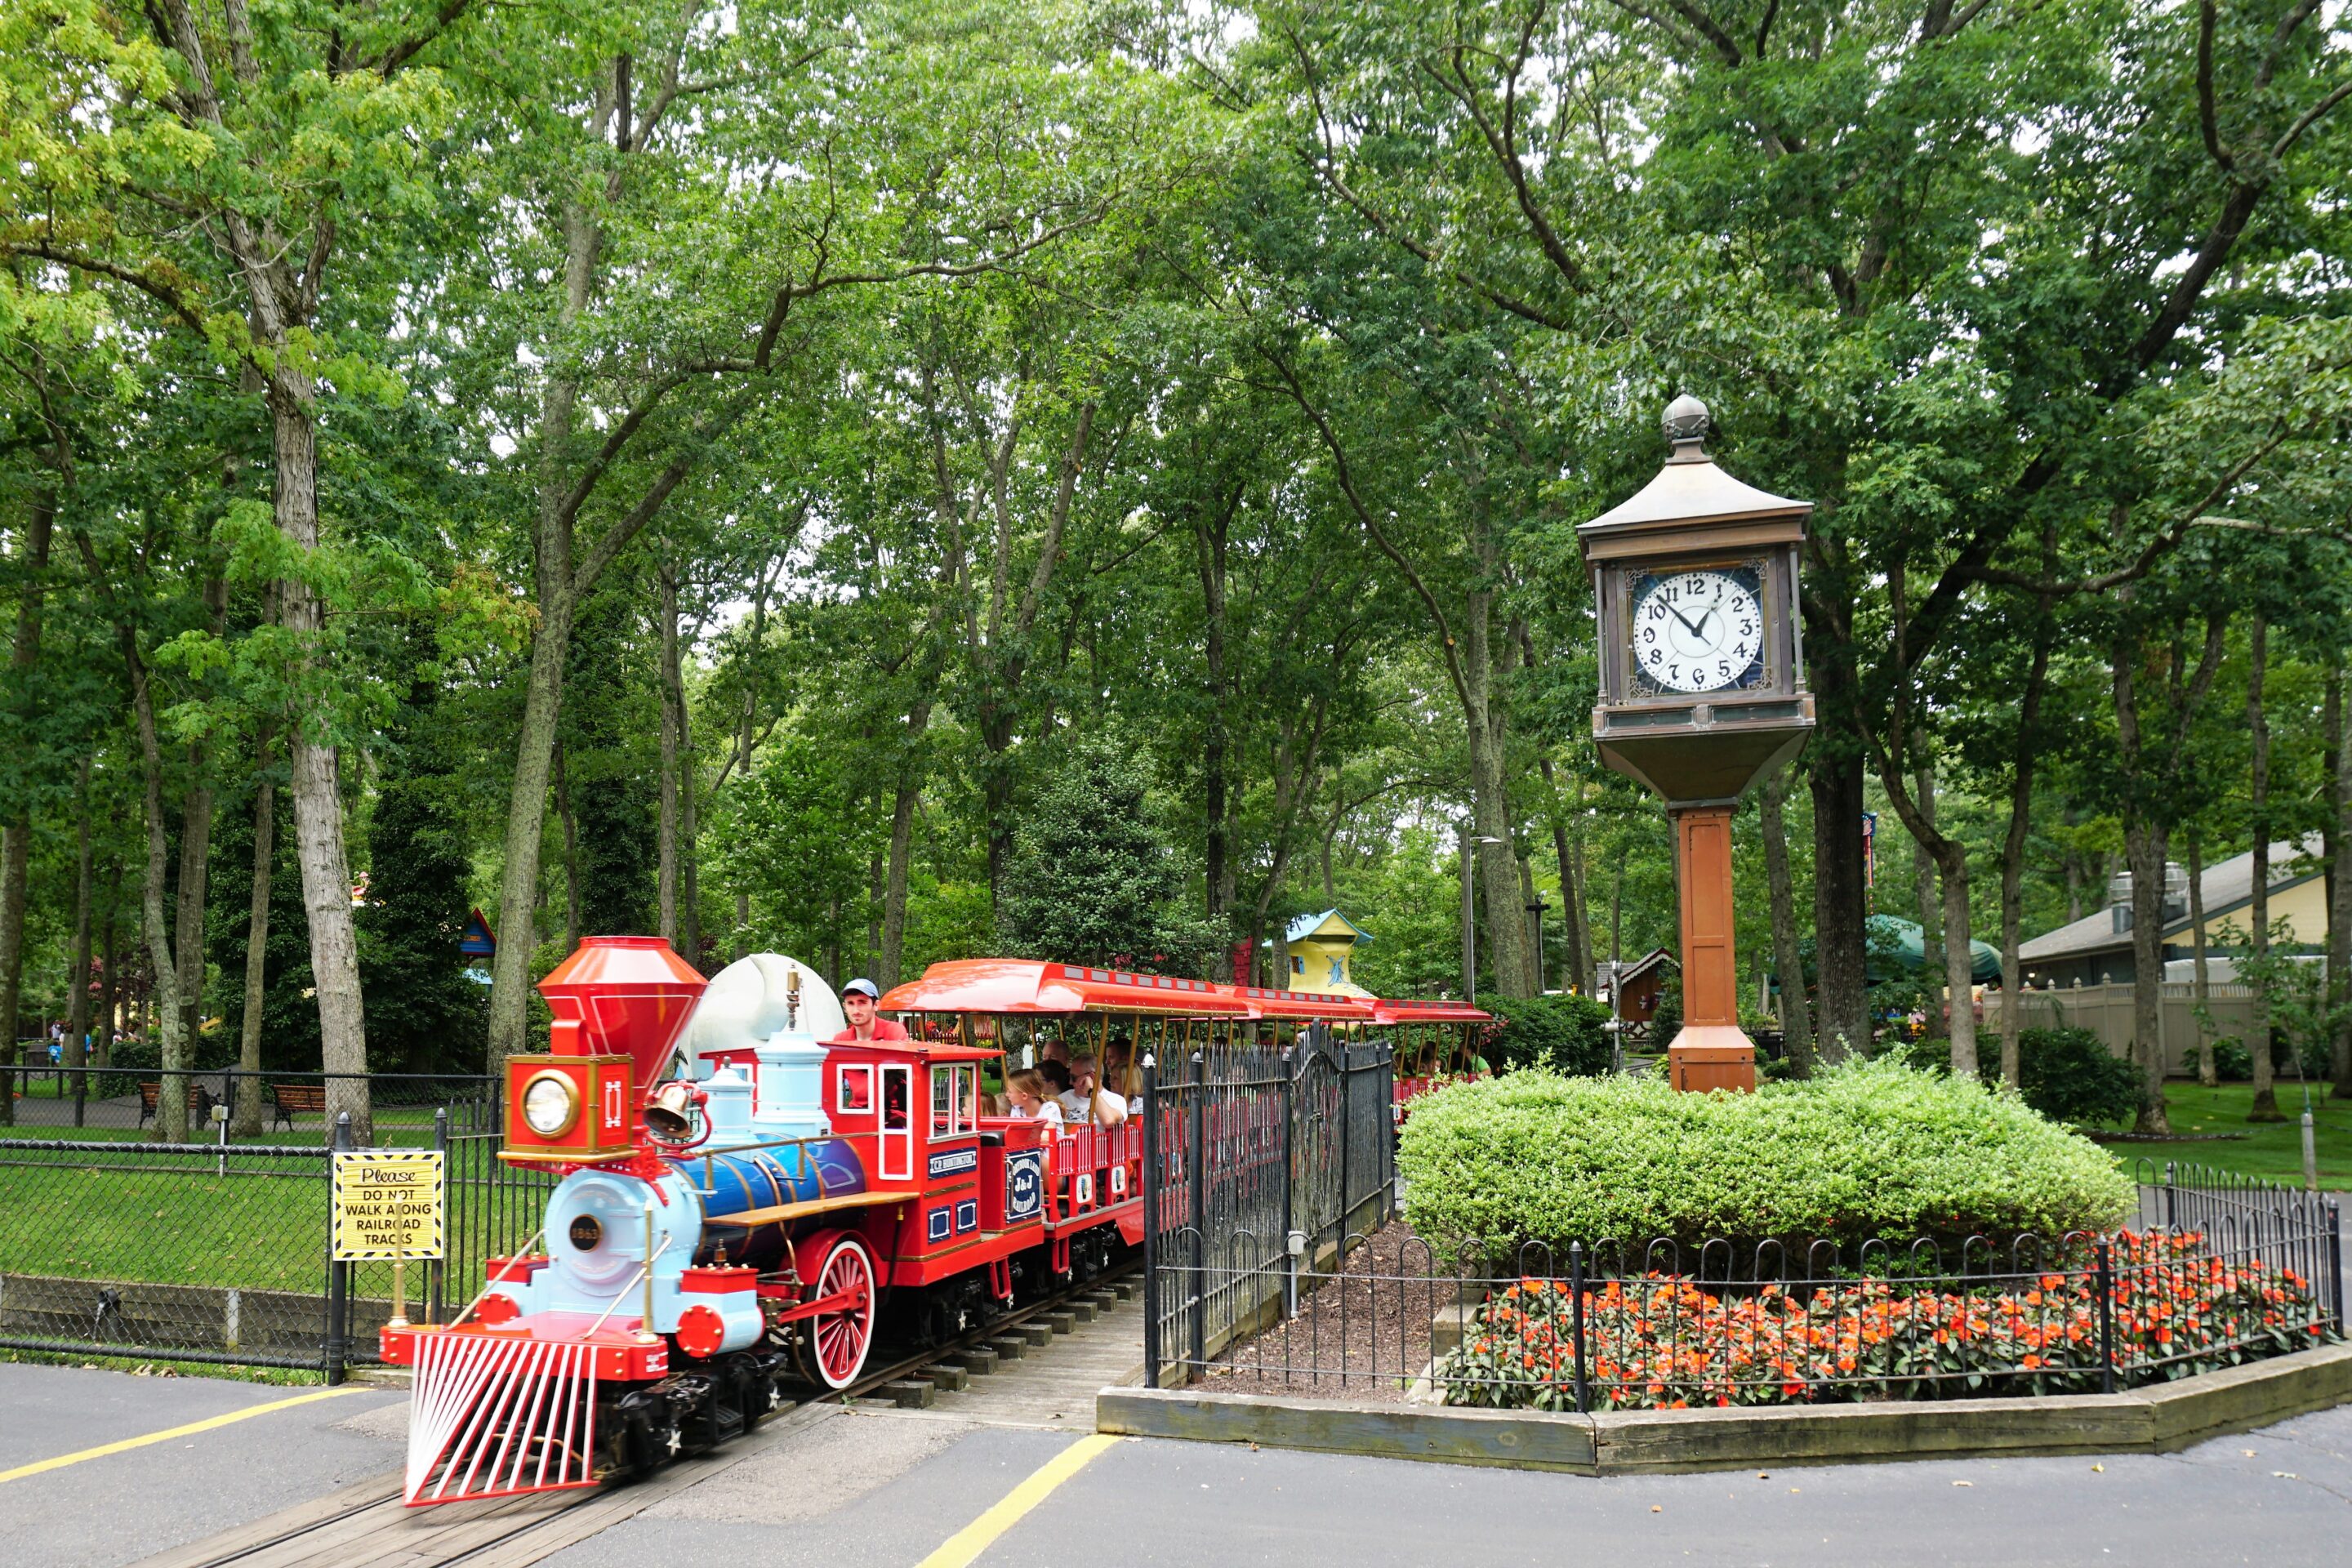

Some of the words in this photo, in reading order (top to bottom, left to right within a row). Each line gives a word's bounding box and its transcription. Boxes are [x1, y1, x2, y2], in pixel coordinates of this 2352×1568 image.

[1665, 586, 1679, 603] 11
[1686, 578, 1705, 595] 12
[1731, 595, 1744, 612] 2
[1648, 604, 1666, 621] 10
[1643, 626, 1656, 644] 9
[1739, 618, 1753, 636] 3
[1650, 648, 1663, 665] 8
[1732, 641, 1748, 659] 4
[1668, 663, 1680, 680] 7
[1692, 668, 1705, 685] 6
[1717, 659, 1731, 677] 5
[361, 1168, 417, 1183] Please
[1014, 1174, 1032, 1192] J&J
[363, 1190, 382, 1200] DO
[345, 1204, 381, 1216] WALK
[386, 1204, 431, 1215] AONG
